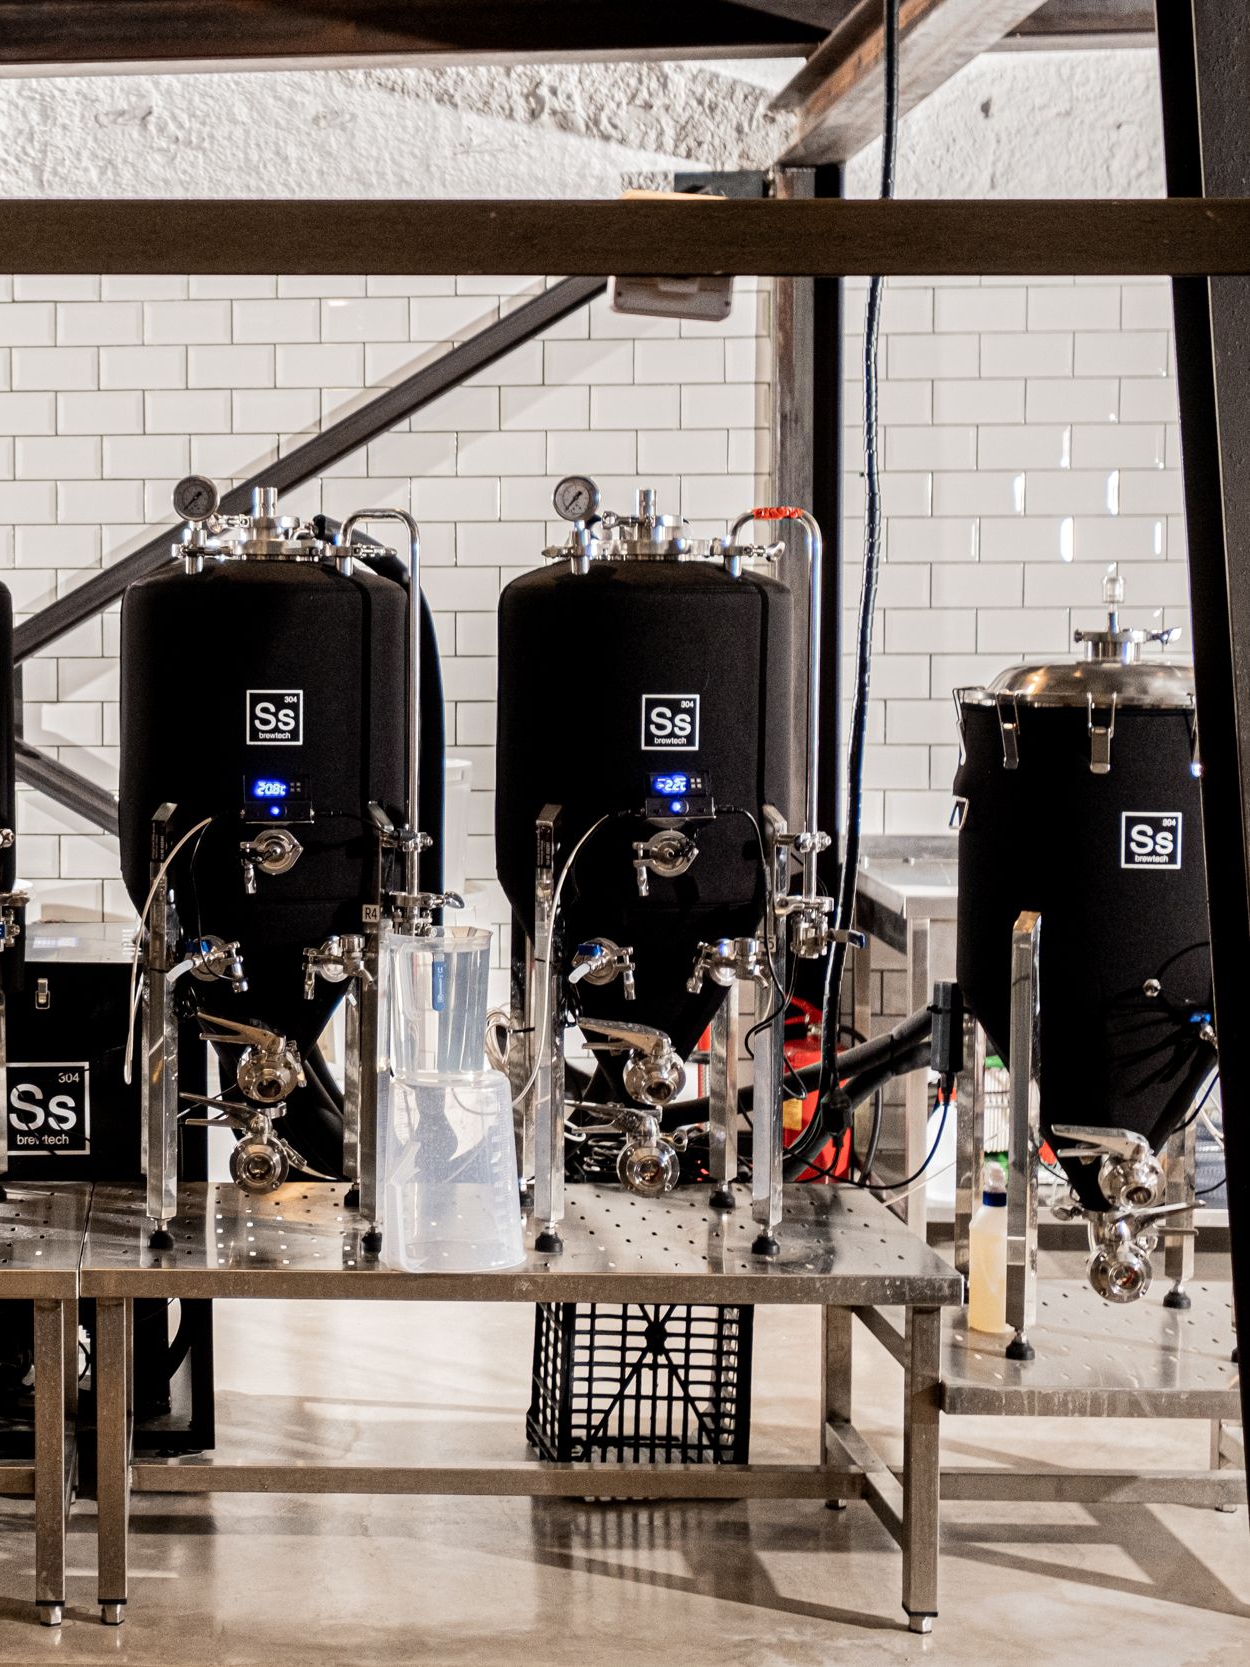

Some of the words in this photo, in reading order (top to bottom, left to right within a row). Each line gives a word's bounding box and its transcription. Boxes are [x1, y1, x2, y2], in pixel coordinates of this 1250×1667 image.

[254, 702, 295, 731] Ss
[650, 706, 692, 736] Ss
[258, 731, 291, 739] brewtech
[1130, 824, 1173, 855] Ss
[364, 907, 377, 920] R4
[58, 1072, 80, 1083] 304
[9, 1083, 77, 1131] Ss
